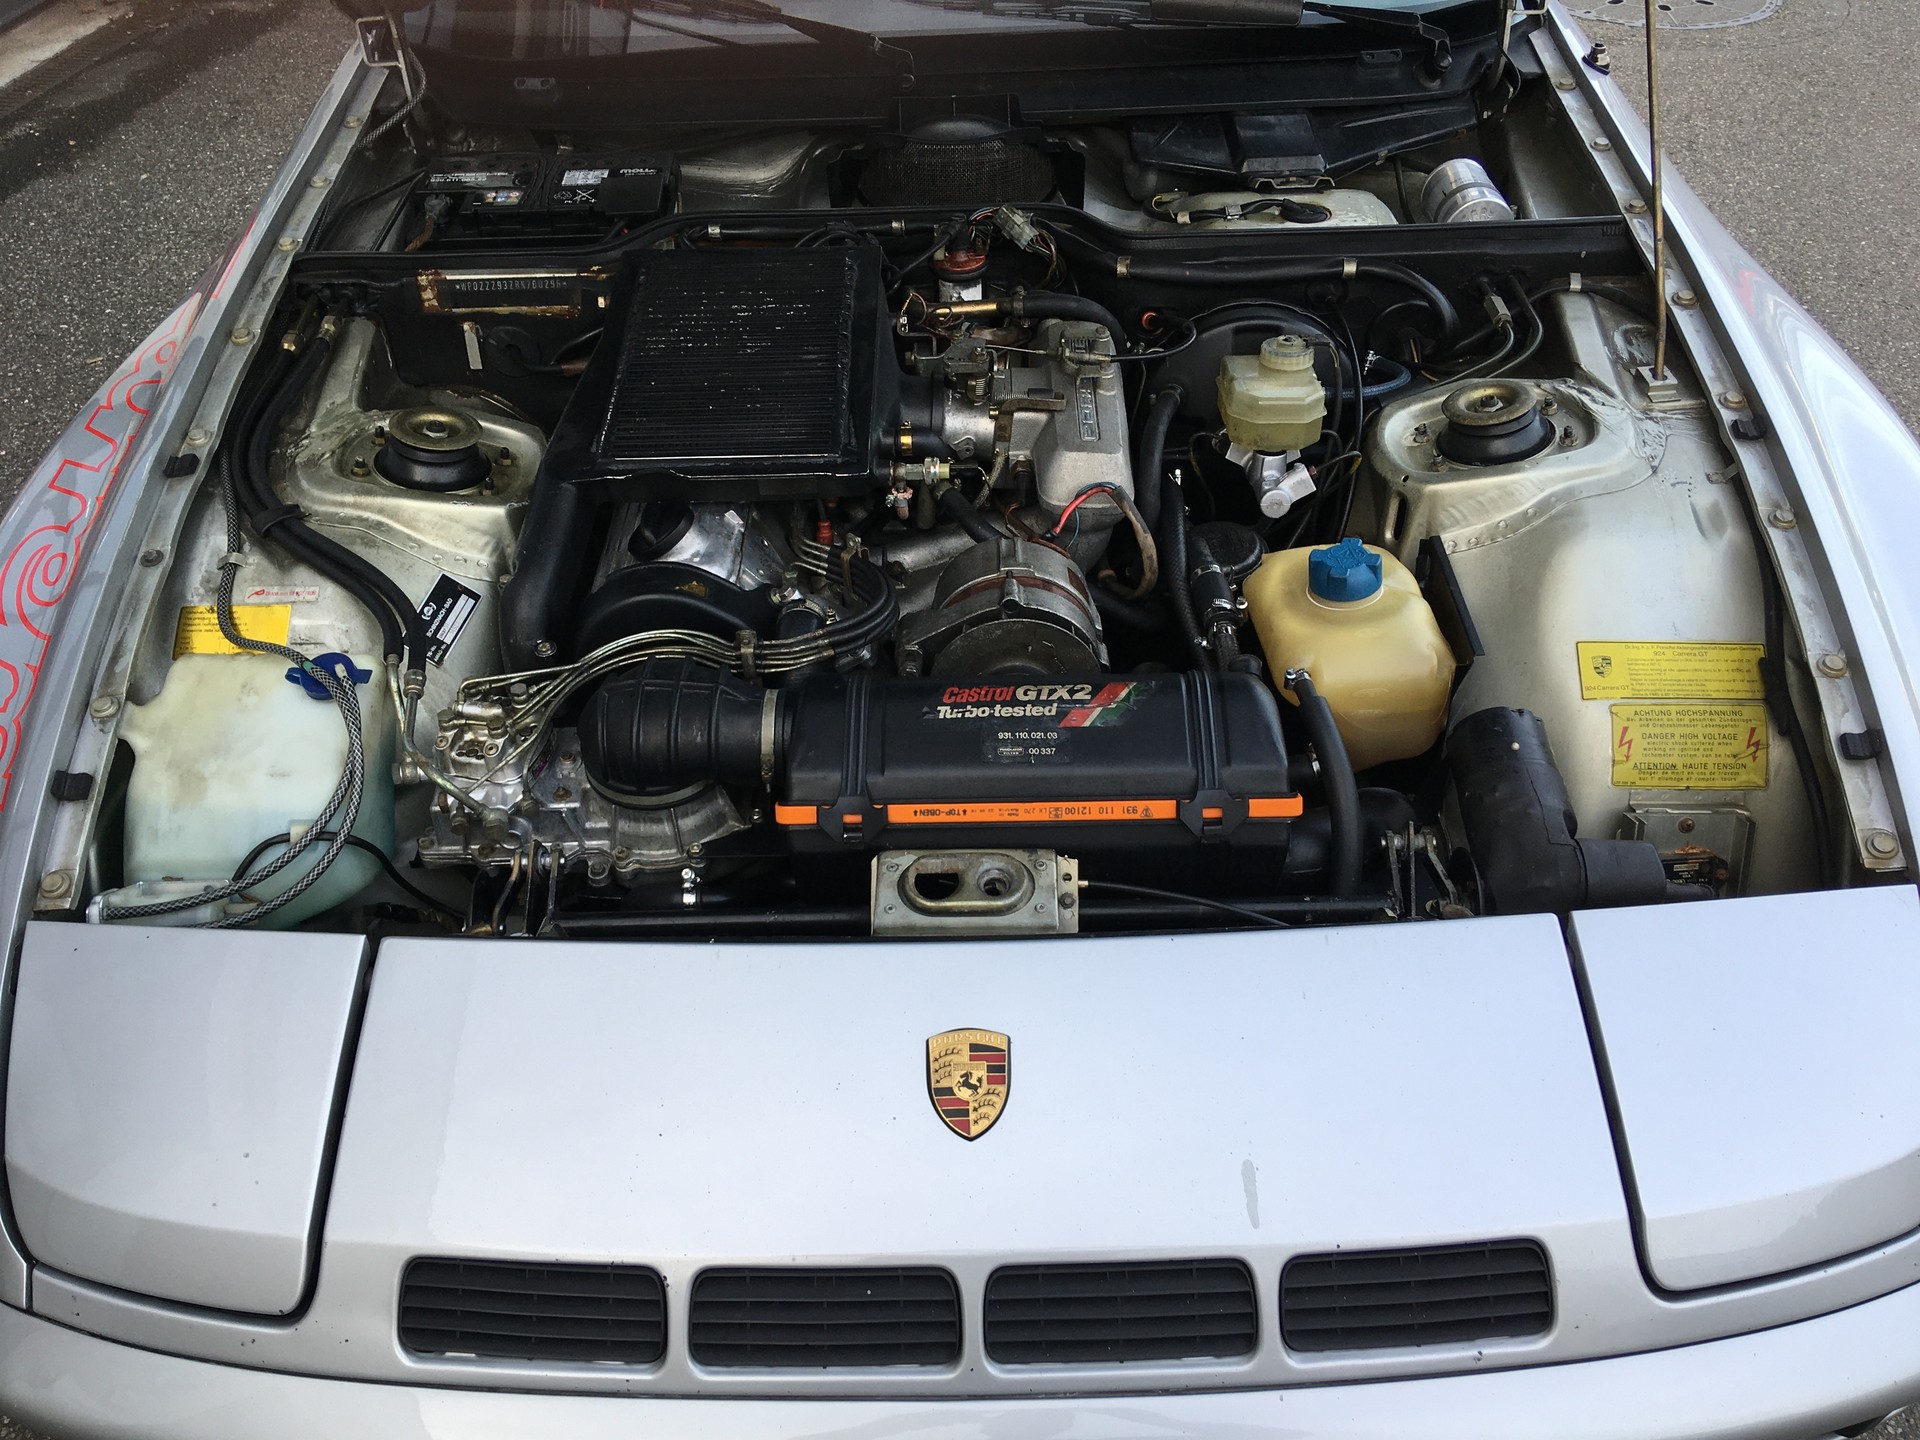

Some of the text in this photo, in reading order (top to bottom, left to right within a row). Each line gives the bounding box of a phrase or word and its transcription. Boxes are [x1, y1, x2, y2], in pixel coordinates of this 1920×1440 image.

[943, 684, 1093, 703] Castrol GTX2
[1633, 709, 1743, 717] ACHTUNG HOCHSPANNUNG
[1682, 762, 1708, 770] HAUTE
[1712, 762, 1747, 770] TENSION
[919, 808, 961, 816] TOP-OBEN
[1064, 805, 1138, 815] 931 110 12100
[933, 1032, 1005, 1048] PORSCHE
